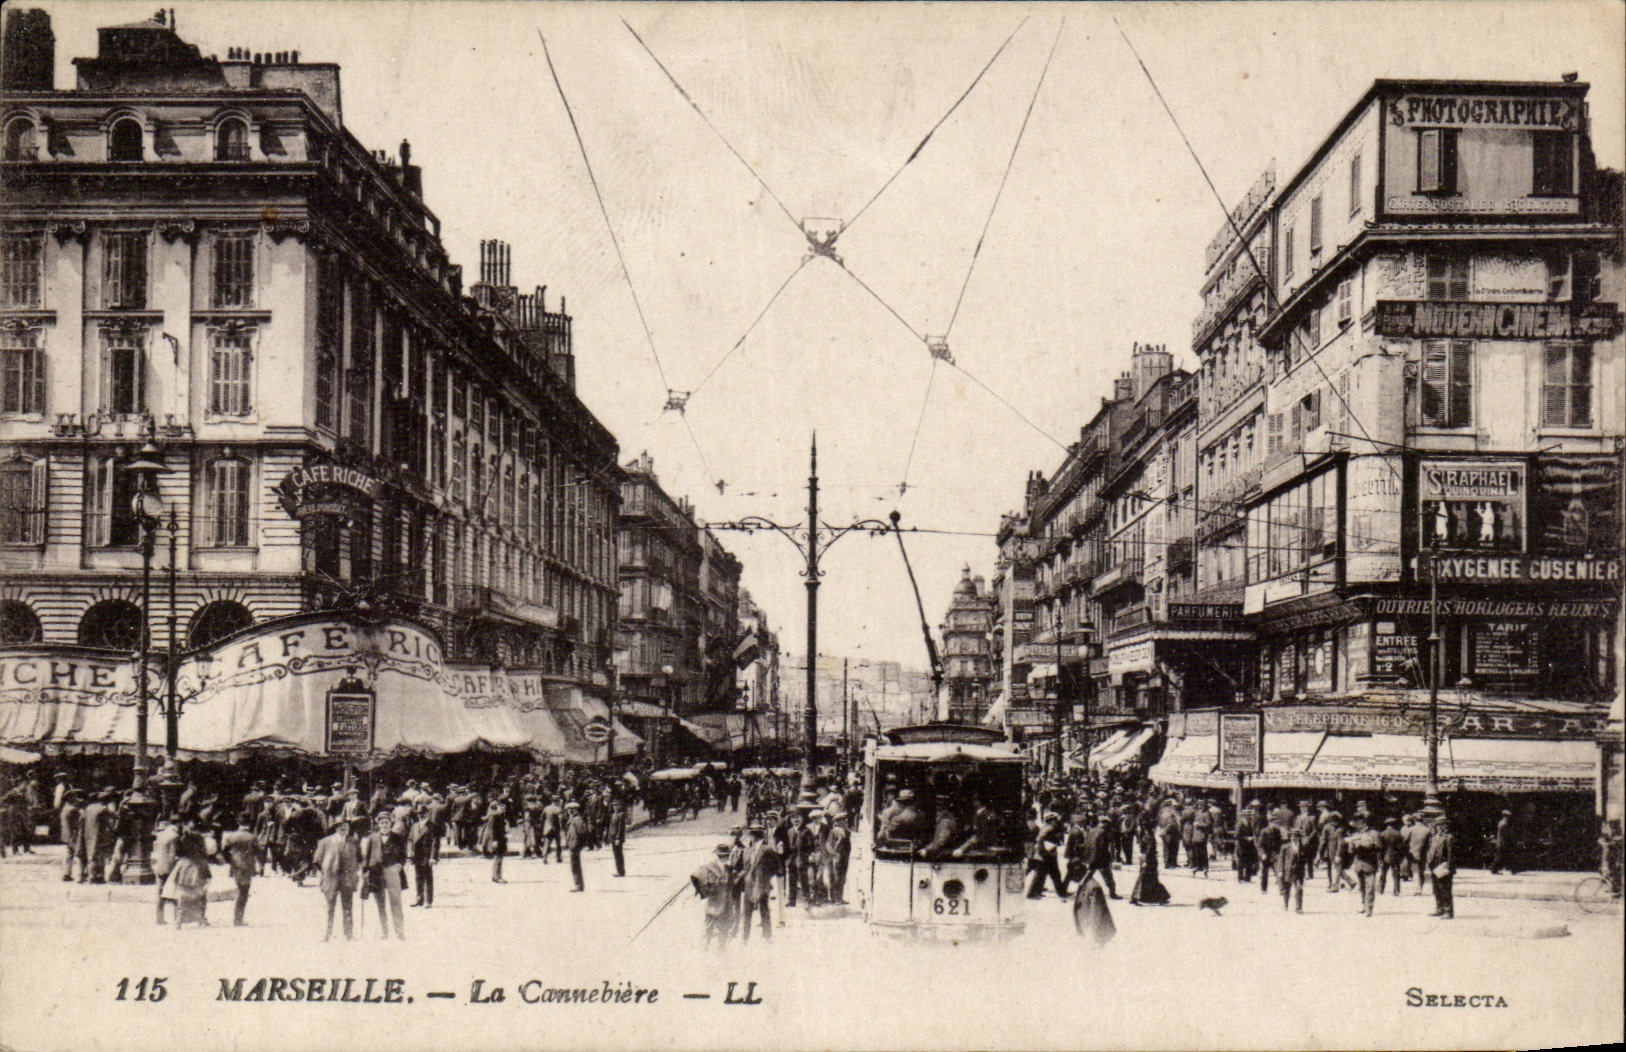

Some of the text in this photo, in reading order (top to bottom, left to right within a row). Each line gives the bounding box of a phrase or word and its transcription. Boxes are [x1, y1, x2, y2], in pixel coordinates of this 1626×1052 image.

[1406, 97, 1562, 126] PHOTOGRAPHIE
[333, 466, 375, 493] RICHE
[1530, 560, 1618, 580] CUSENIER
[1170, 604, 1243, 618] PARFUMERI
[1376, 599, 1451, 614] OUVRIERS
[1454, 601, 1544, 616] HORLOGERS
[1488, 623, 1529, 632] TARIF
[933, 898, 970, 915] 621
